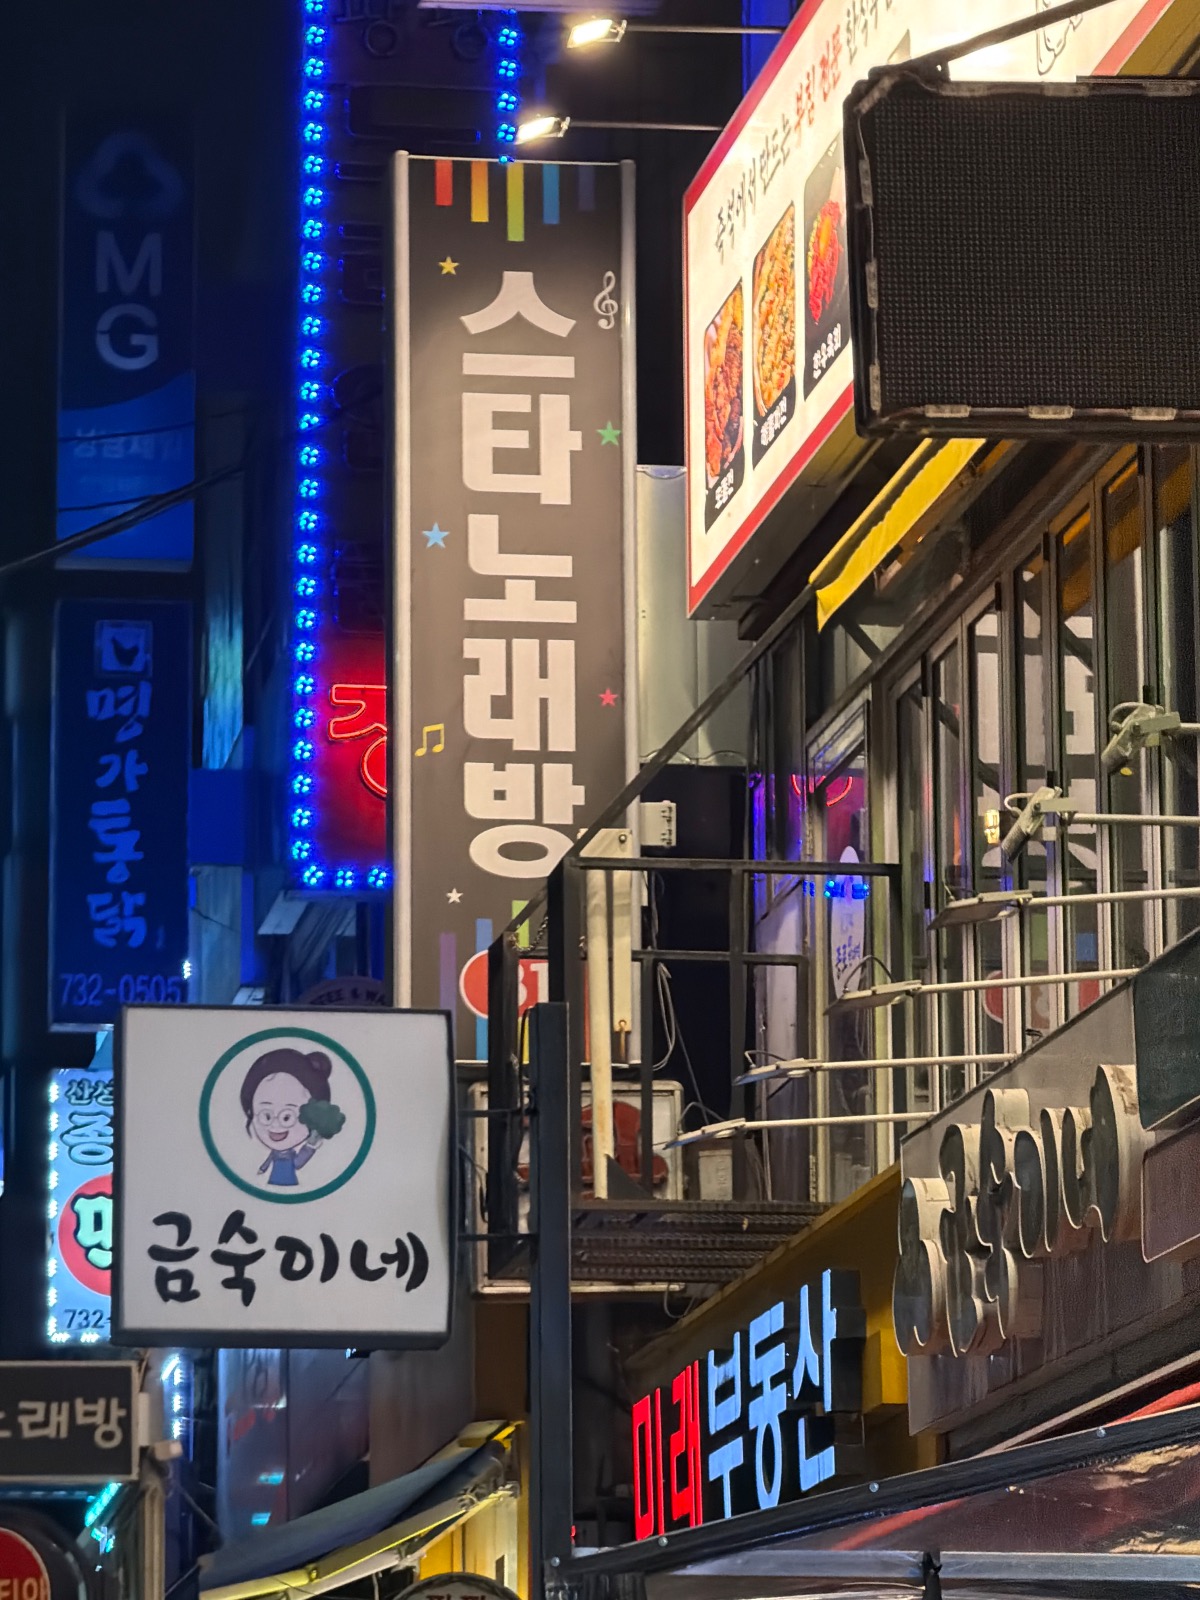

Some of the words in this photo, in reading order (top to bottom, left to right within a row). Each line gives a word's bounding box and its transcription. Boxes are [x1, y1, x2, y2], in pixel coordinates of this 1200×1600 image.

[459, 270, 586, 879] 스타노래방
[60, 973, 182, 1006] 732-0505
[147, 1209, 429, 1307] 금숙이네
